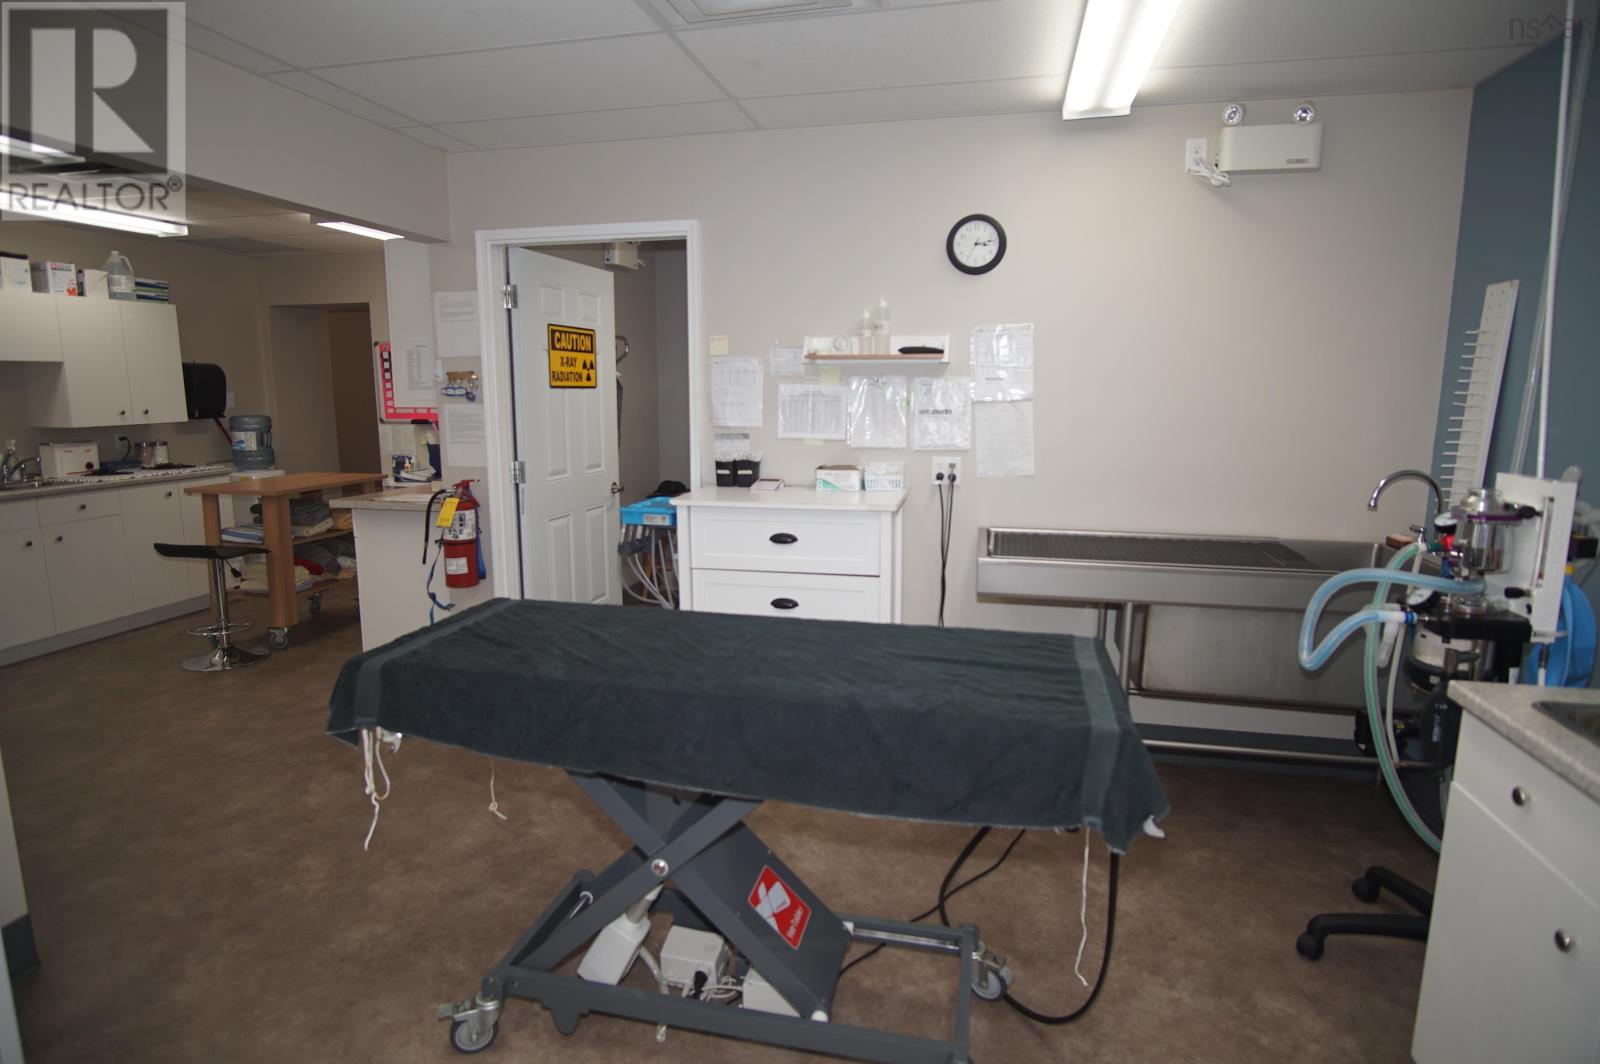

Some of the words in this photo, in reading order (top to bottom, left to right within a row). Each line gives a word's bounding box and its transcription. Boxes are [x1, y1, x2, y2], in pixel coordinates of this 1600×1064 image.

[554, 332, 592, 351] CAUTION
[560, 356, 577, 368] X-RAY
[552, 371, 583, 382] RADIATION
